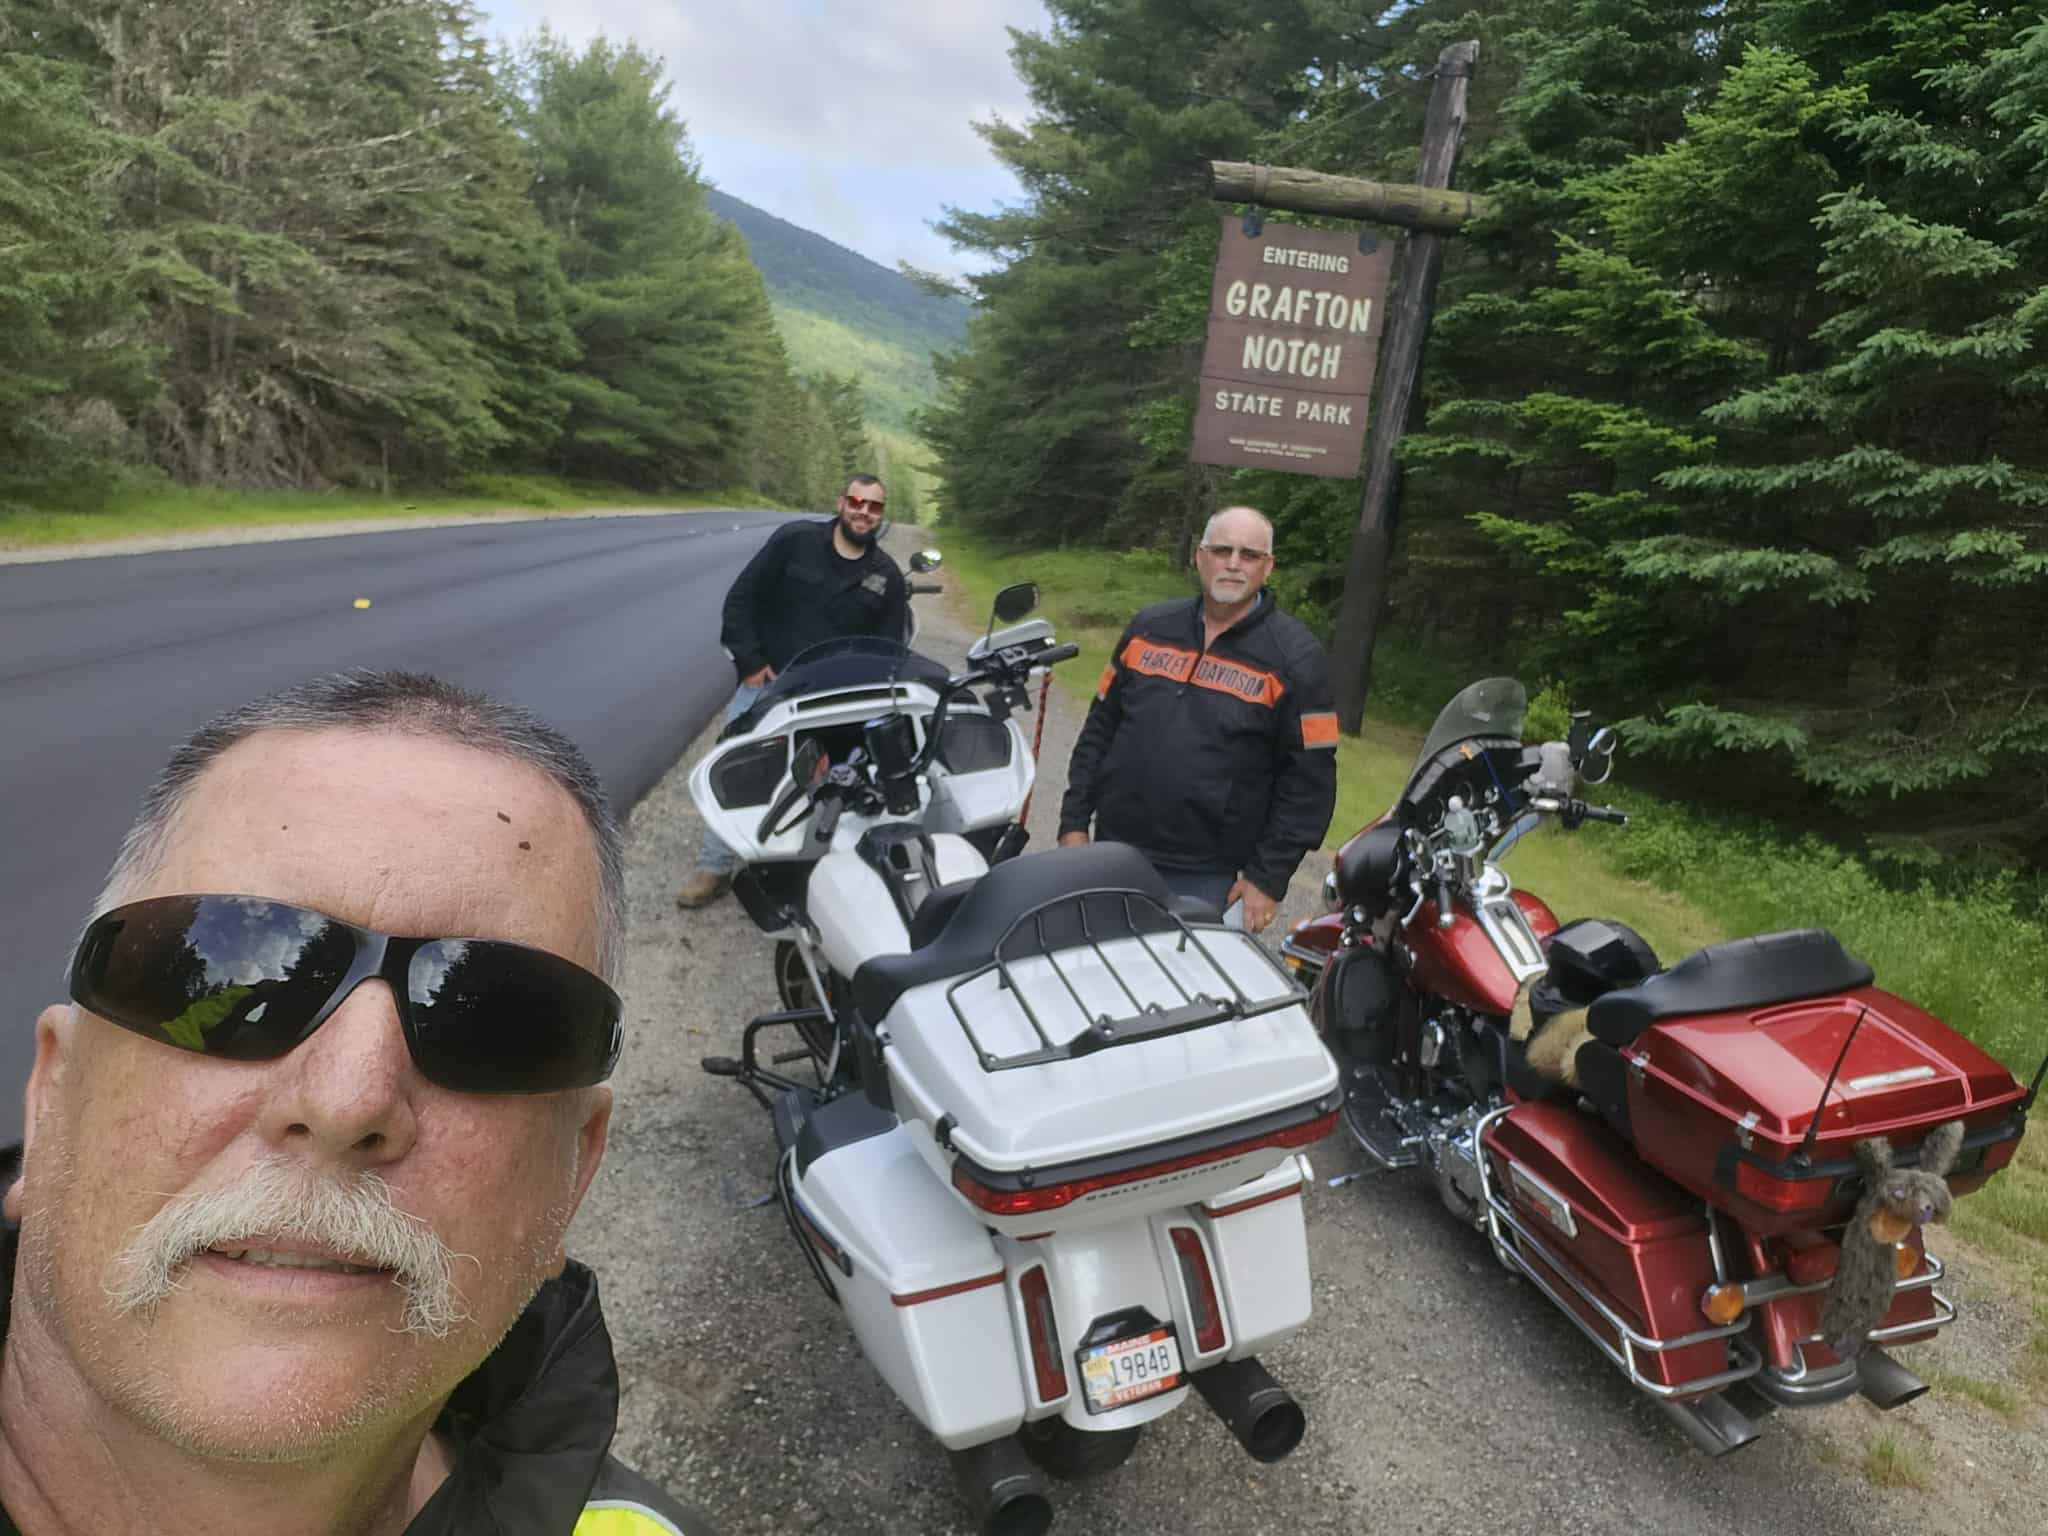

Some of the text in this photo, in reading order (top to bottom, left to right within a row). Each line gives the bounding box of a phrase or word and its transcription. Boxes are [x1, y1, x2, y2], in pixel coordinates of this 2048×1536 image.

[1263, 246, 1349, 273] ENTERING
[1226, 280, 1372, 332] GRAFTON
[1242, 335, 1342, 379] NOTCH
[1215, 390, 1352, 425] STATE PARK
[1196, 660, 1265, 697] DAVIDSON
